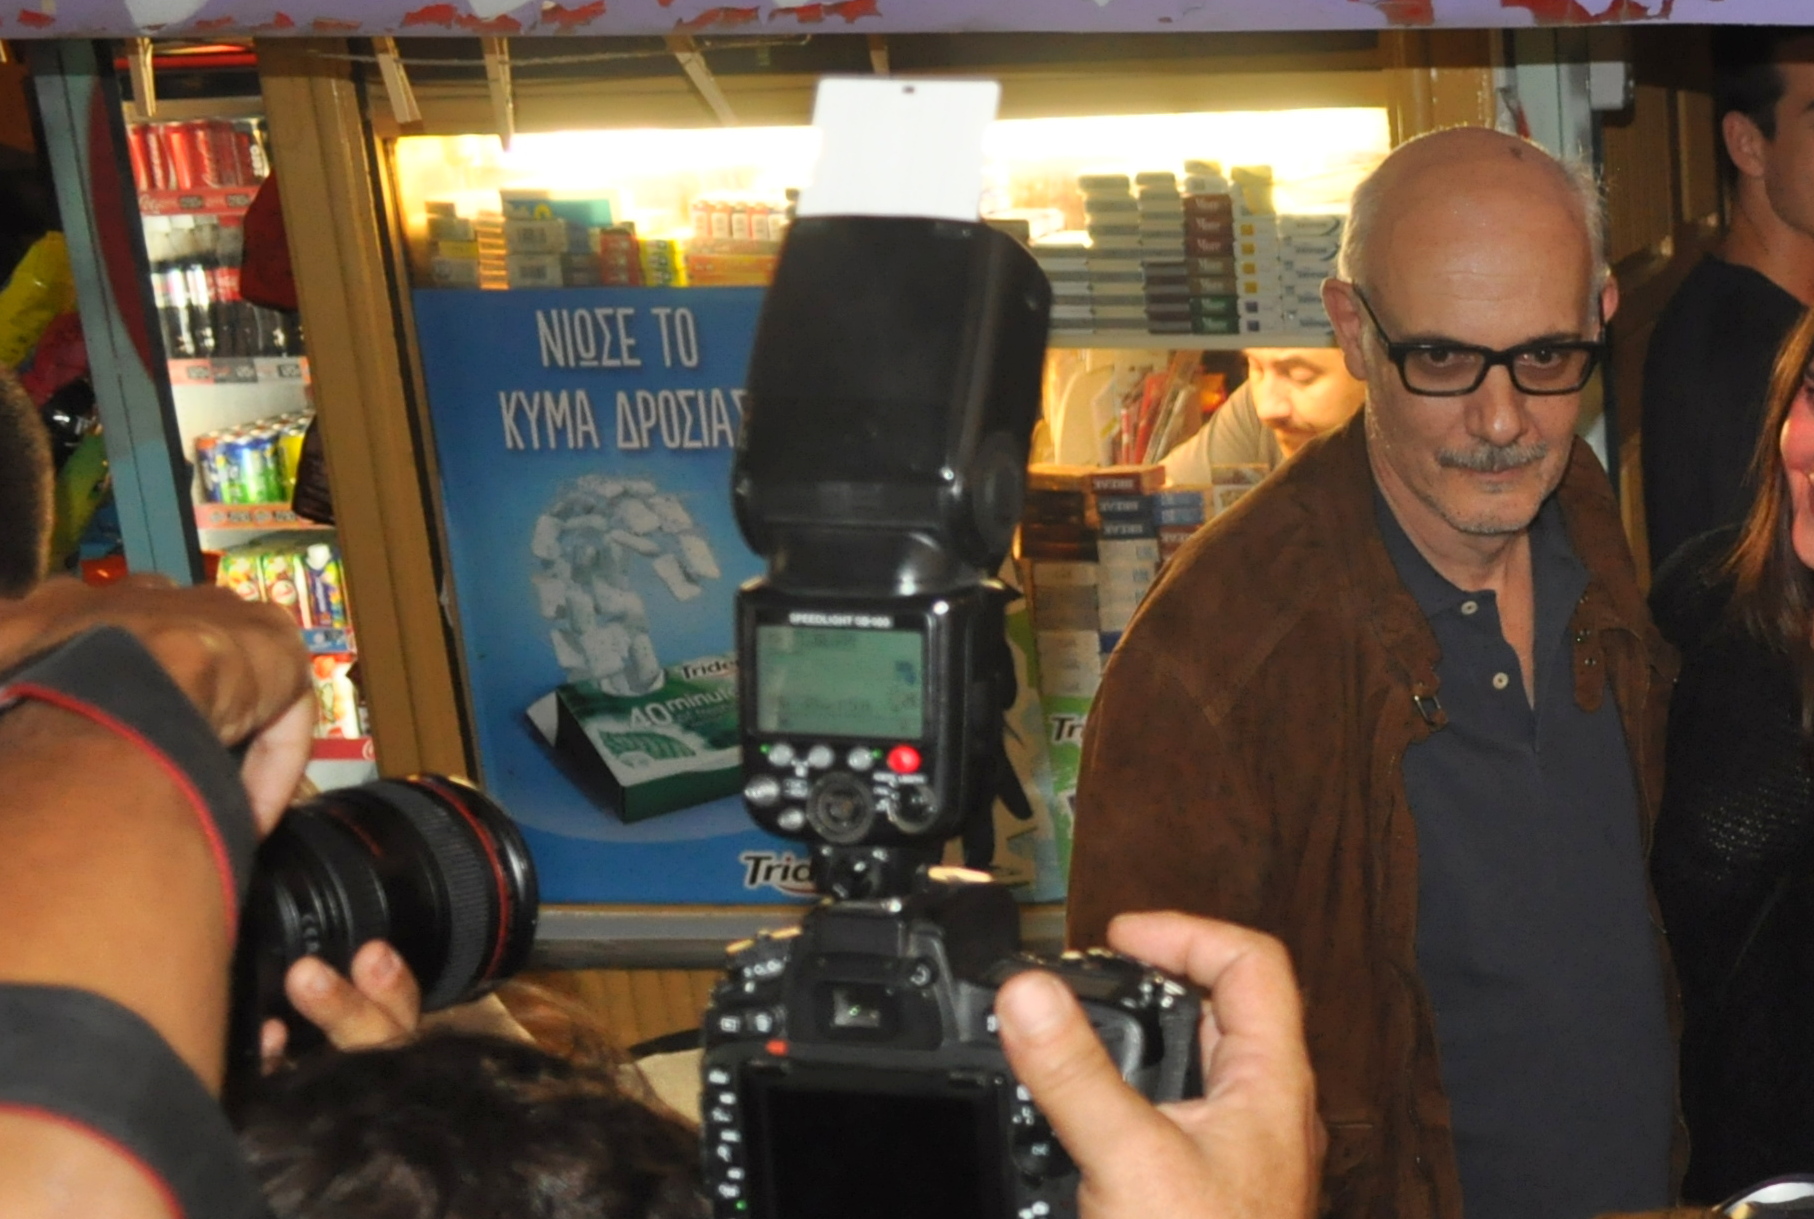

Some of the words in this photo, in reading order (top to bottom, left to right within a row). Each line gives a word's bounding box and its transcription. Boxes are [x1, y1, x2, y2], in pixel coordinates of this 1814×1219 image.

[536, 307, 642, 368] ΝΙΩΣΕ
[651, 306, 699, 369] ΤΟ
[499, 389, 600, 450] ΚΥΜΑ
[630, 702, 674, 729] 40
